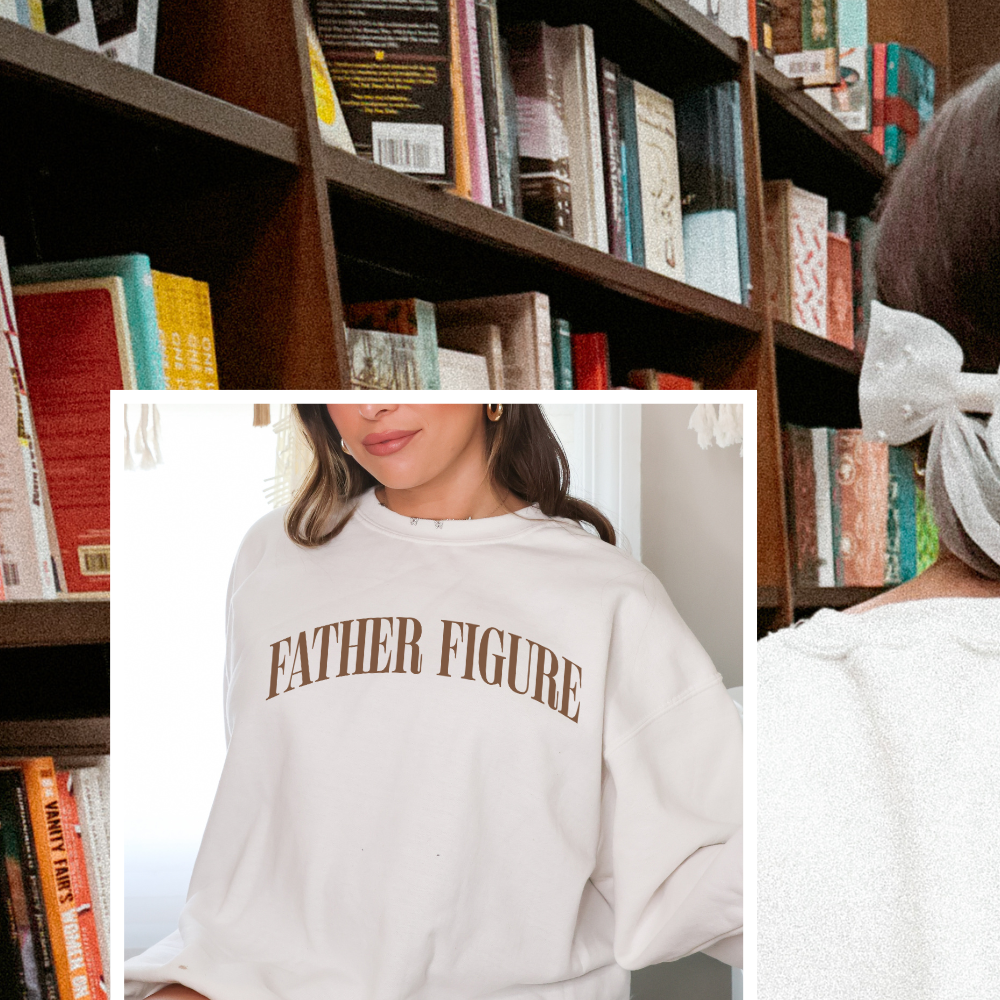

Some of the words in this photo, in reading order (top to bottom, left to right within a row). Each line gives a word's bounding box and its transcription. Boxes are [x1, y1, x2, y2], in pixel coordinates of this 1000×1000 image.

[265, 616, 423, 701] FATHER
[436, 619, 583, 724] FIGURE
[45, 800, 66, 852] VANITY
[53, 858, 74, 904] FAIR'S
[61, 907, 85, 972] WOMEN
[71, 974, 90, 999] ON
